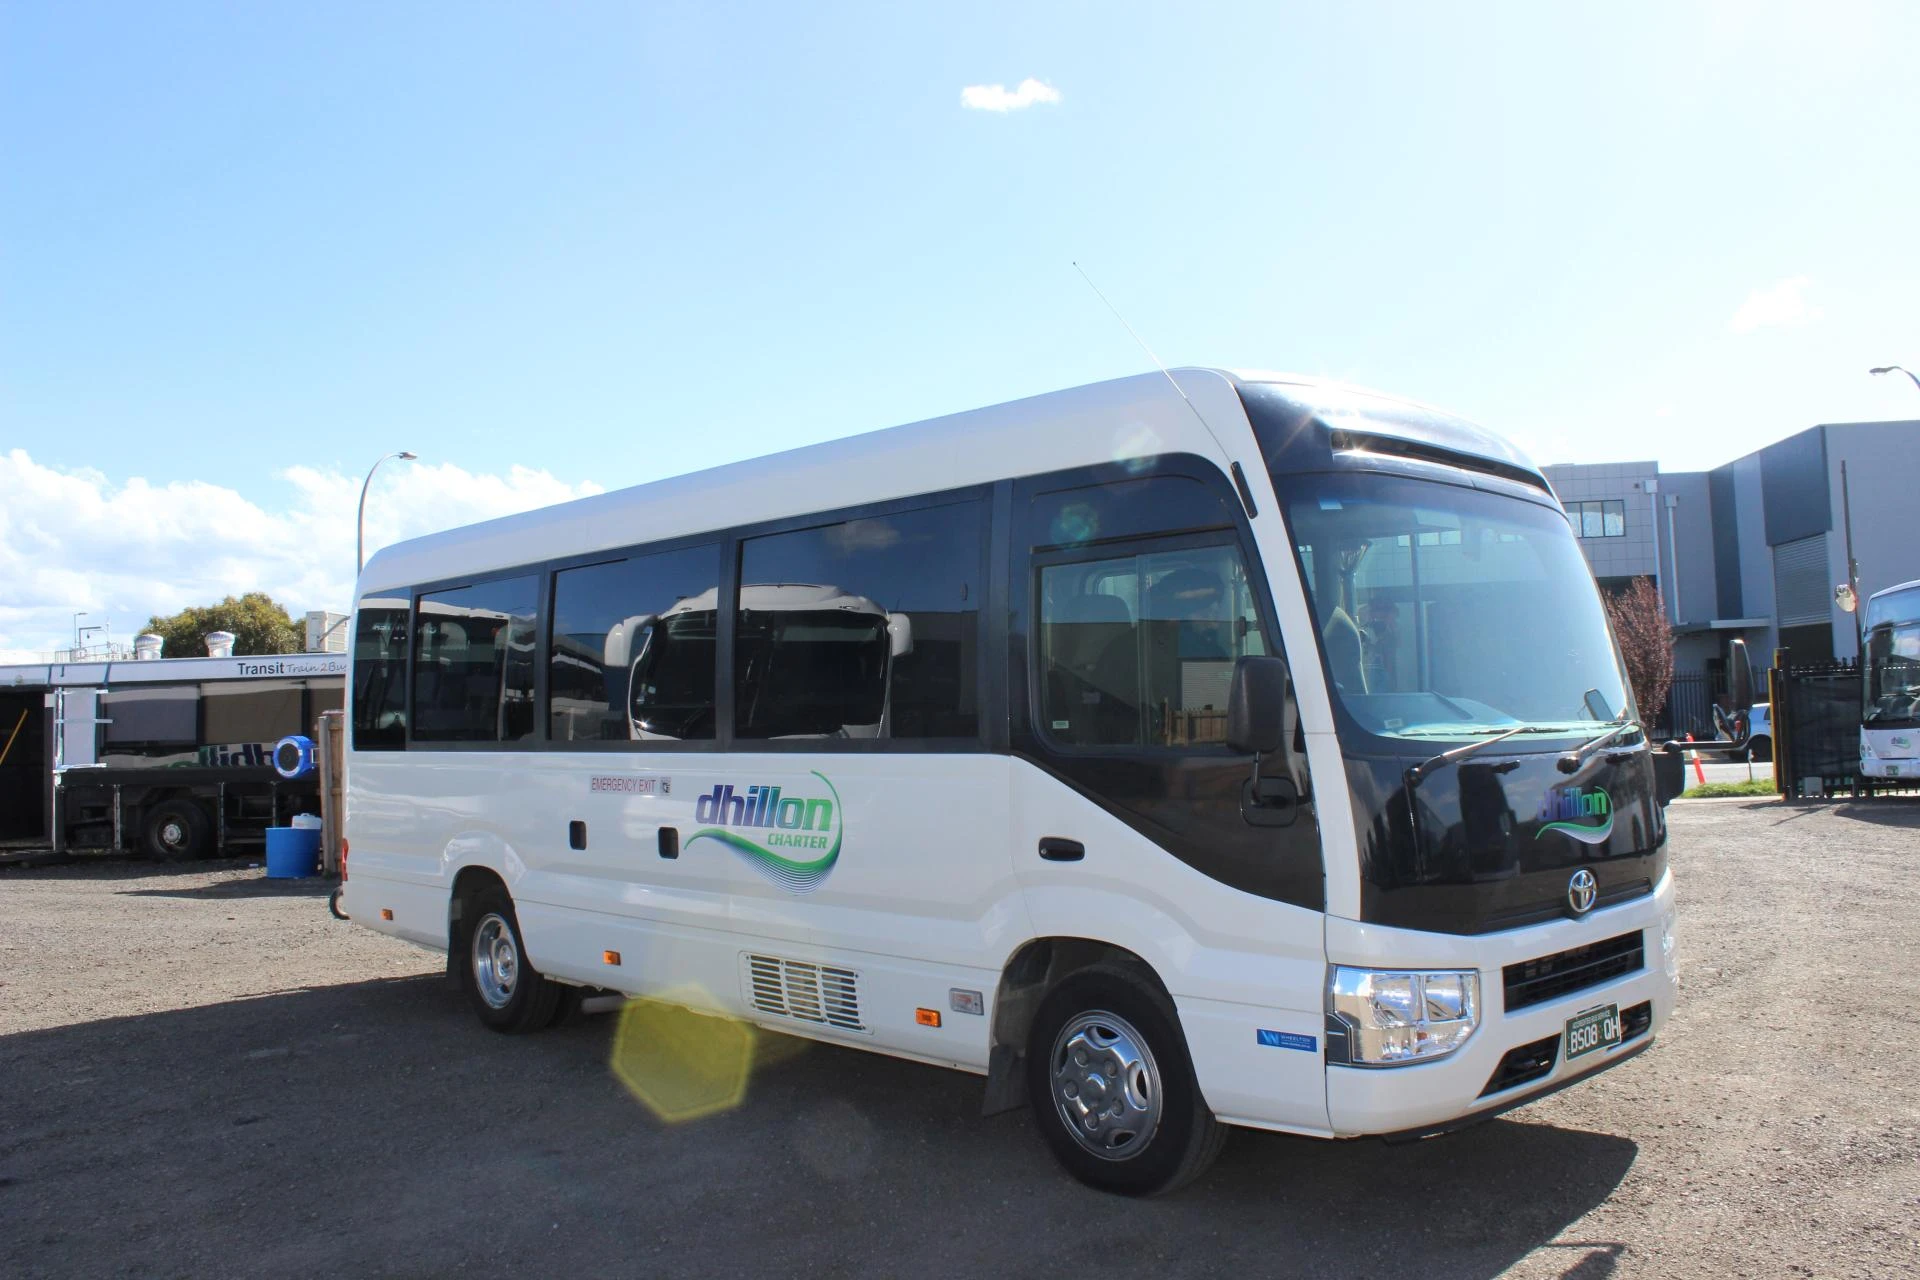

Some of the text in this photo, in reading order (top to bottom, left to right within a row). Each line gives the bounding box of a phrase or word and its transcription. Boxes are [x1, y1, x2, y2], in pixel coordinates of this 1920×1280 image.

[237, 661, 285, 675] Transit
[592, 777, 656, 793] EMERGENCY EXIT
[695, 784, 833, 832] dhillon
[1536, 786, 1607, 821] dhillon
[767, 833, 829, 850] CHARTER
[1571, 1016, 1619, 1053] BS08 QH
